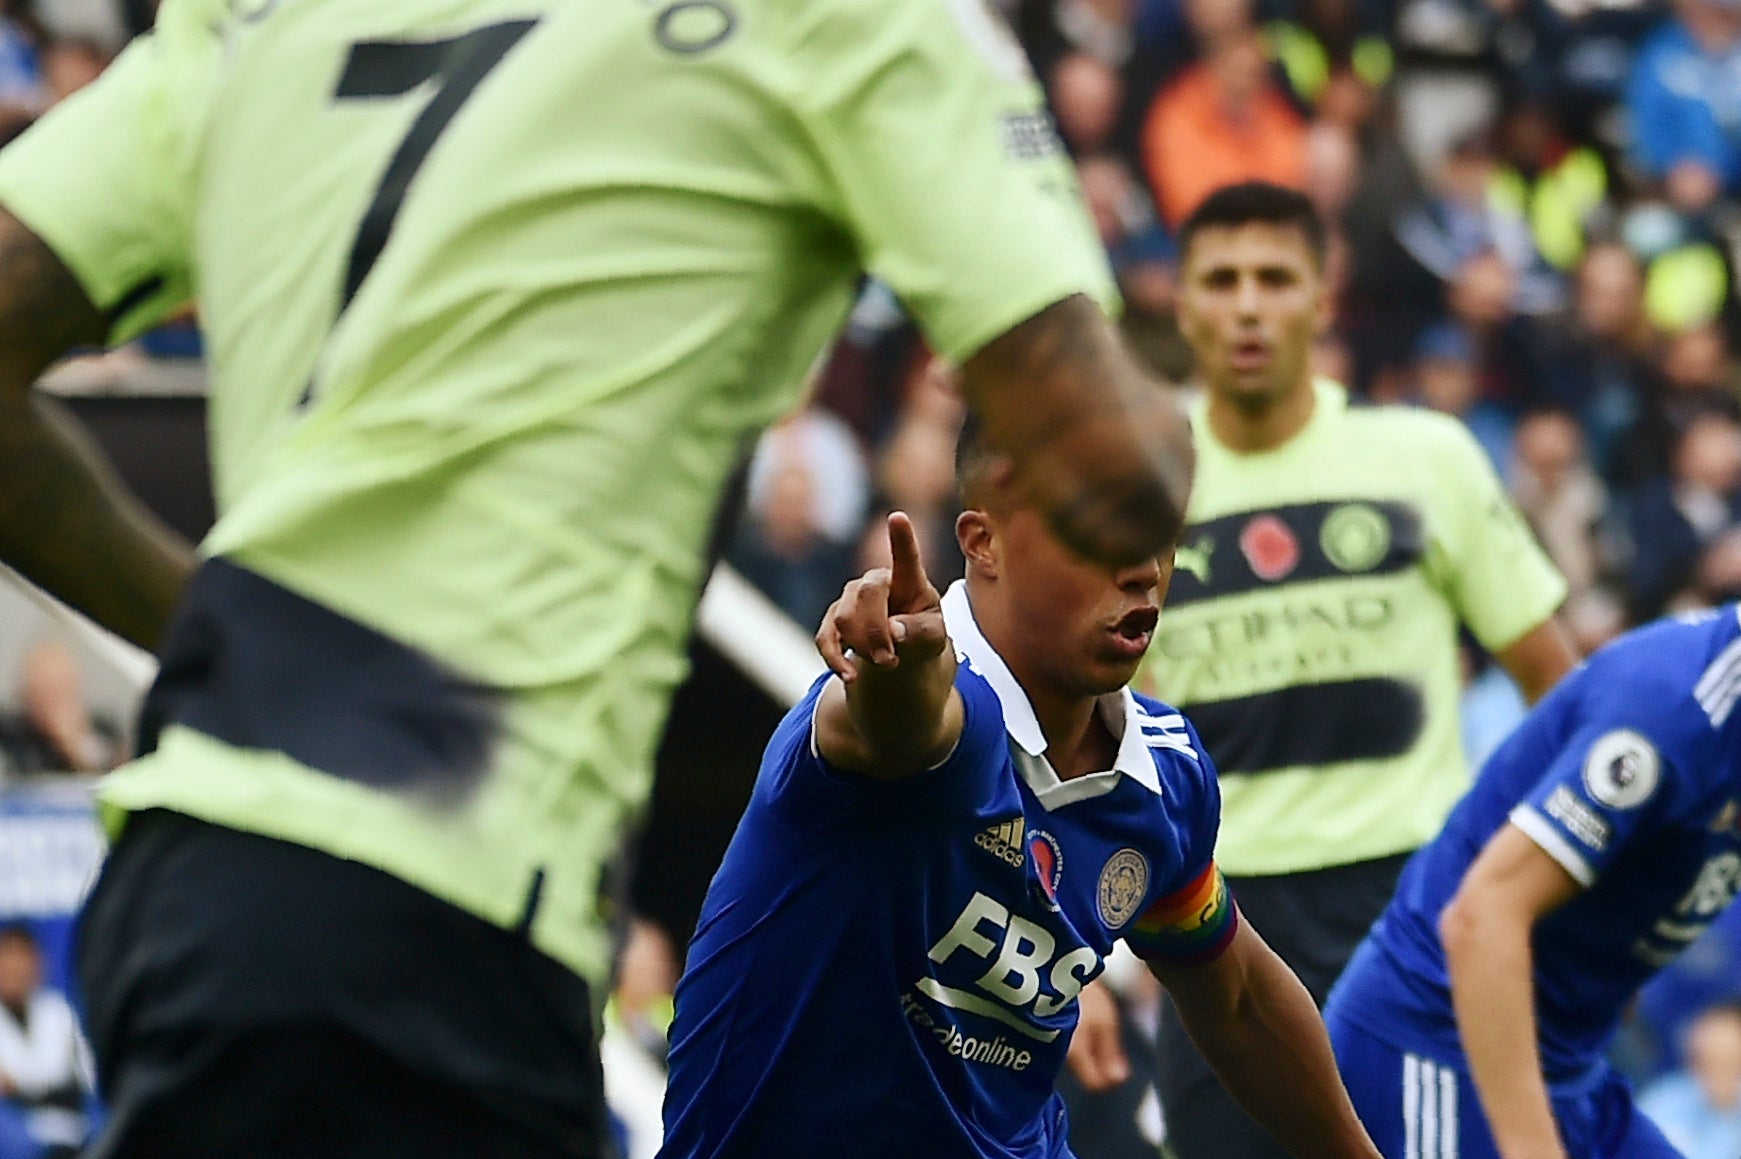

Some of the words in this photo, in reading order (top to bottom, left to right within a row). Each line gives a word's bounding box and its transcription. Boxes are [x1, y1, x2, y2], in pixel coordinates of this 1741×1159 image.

[293, 16, 543, 412] 7
[974, 833, 1024, 867] adidas
[927, 891, 1098, 1017] FBS
